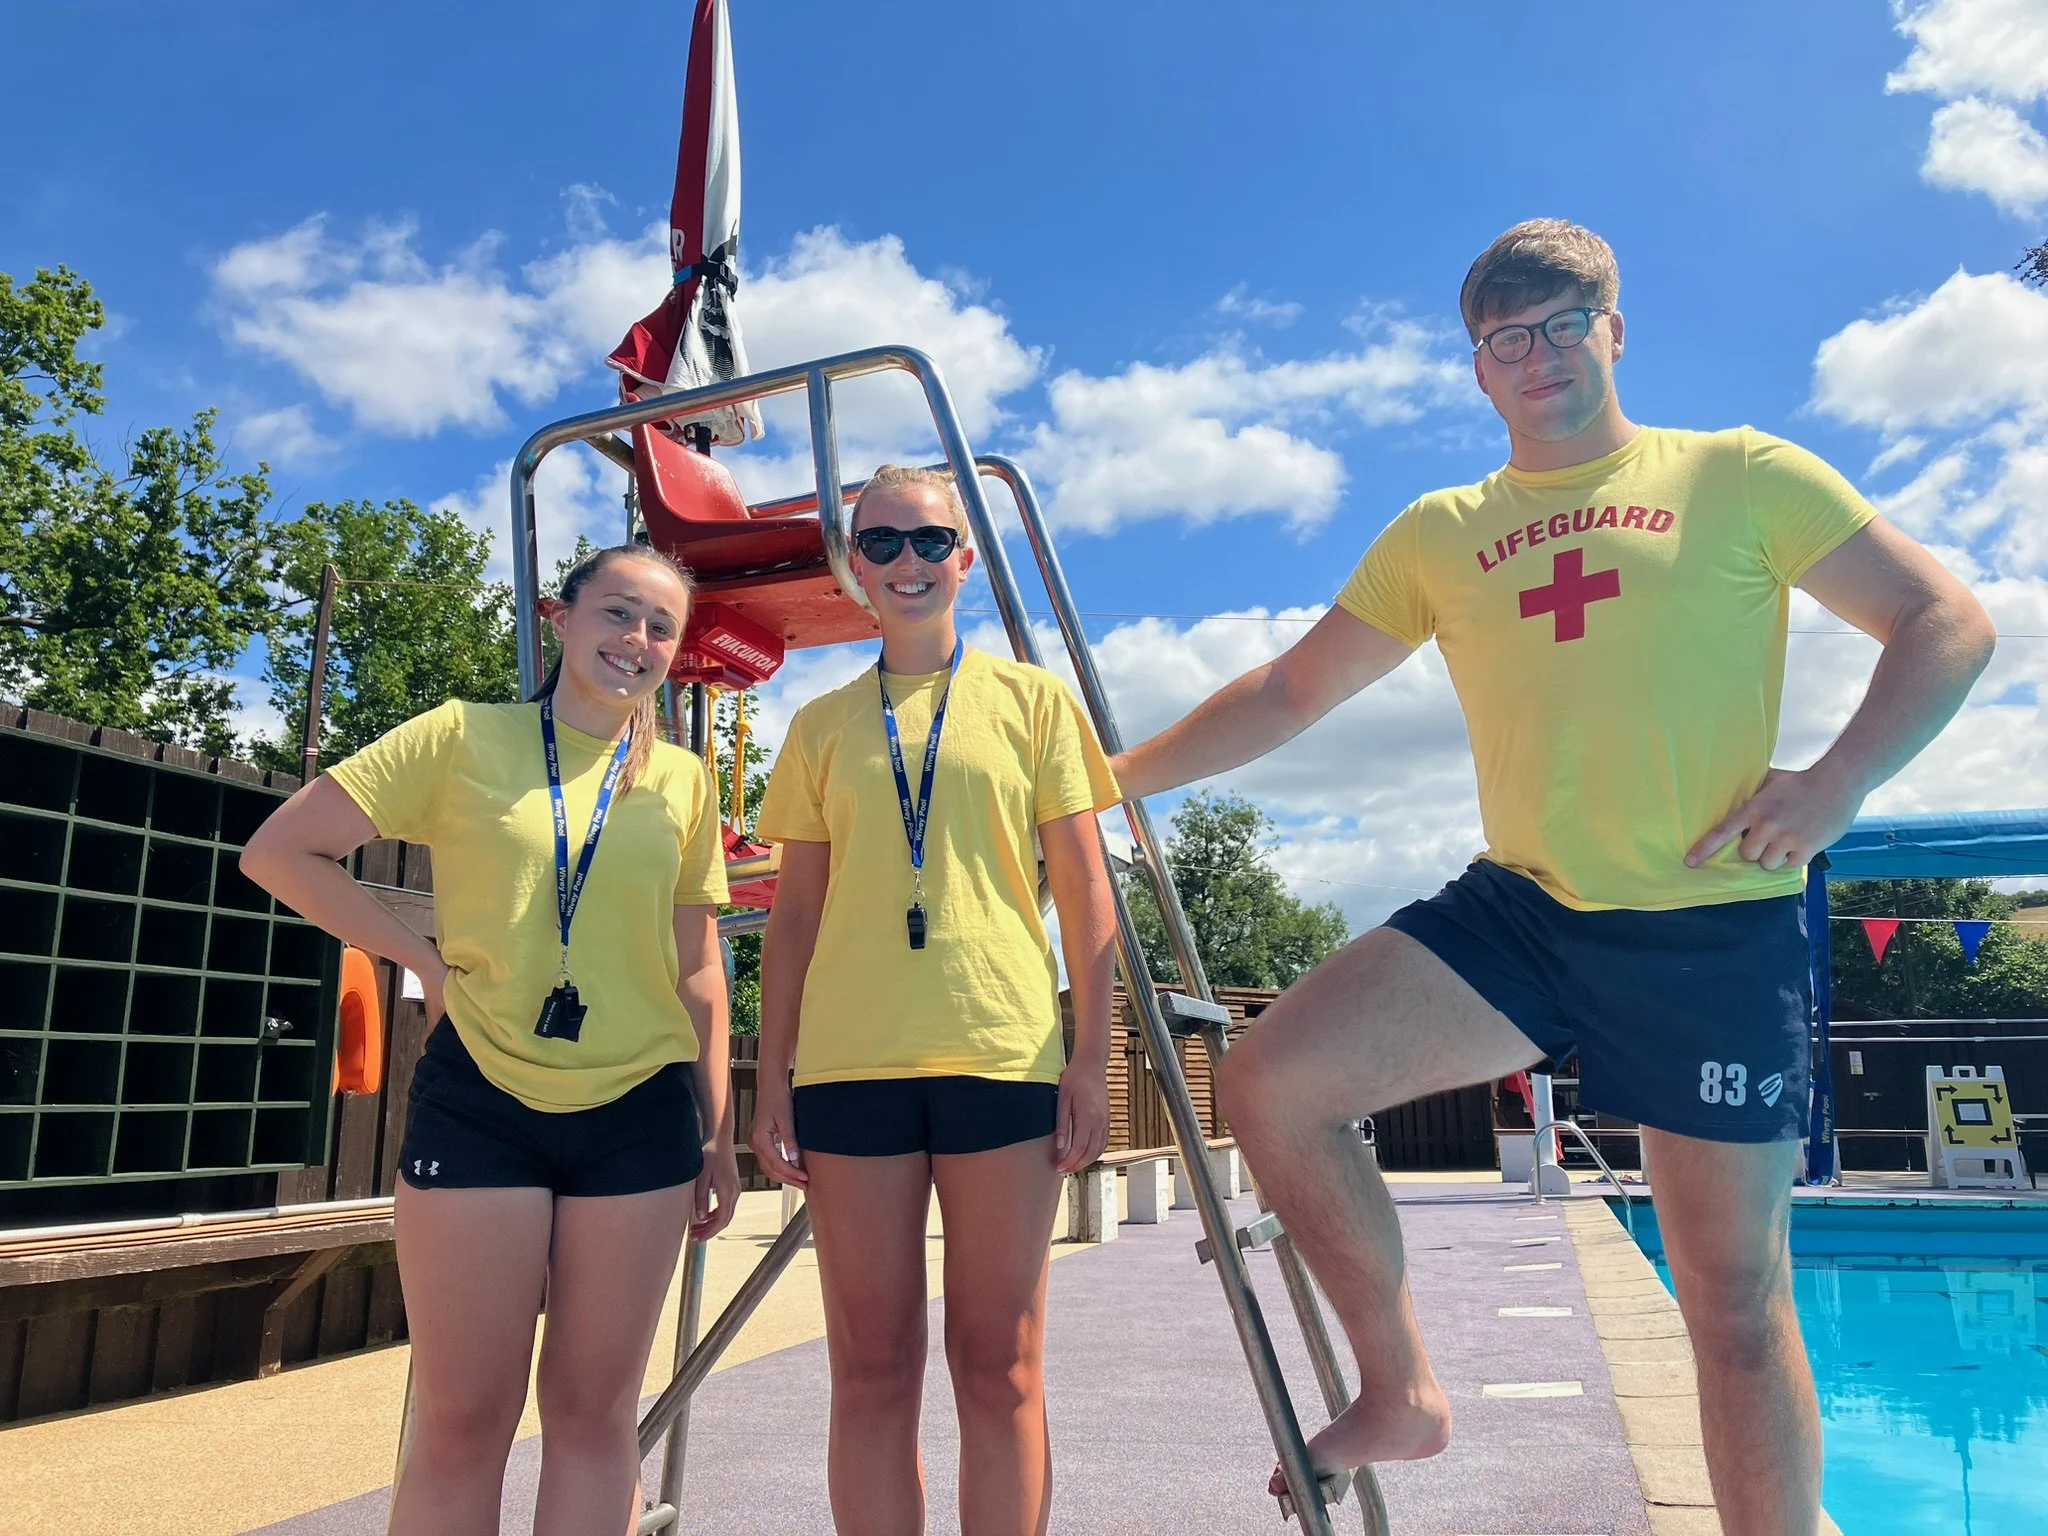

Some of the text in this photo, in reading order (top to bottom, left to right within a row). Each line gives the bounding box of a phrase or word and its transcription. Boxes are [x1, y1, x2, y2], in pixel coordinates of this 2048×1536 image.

[1476, 505, 1675, 574] LIFEGUARD
[711, 633, 778, 672] EVACUATOR
[548, 742, 559, 777] Wivey Pool
[890, 736, 903, 773] Wivey Pool
[924, 733, 938, 772] Wivey Pool
[554, 798, 566, 836] Wivey Pool
[586, 808, 603, 845] Wivey Pool
[902, 798, 911, 821] Wivey
[915, 798, 927, 841] Wivey Pool
[566, 872, 584, 917] Wivey Pool
[1699, 1061, 1747, 1107] 83
[1822, 1094, 1832, 1144] Wivey Pool
